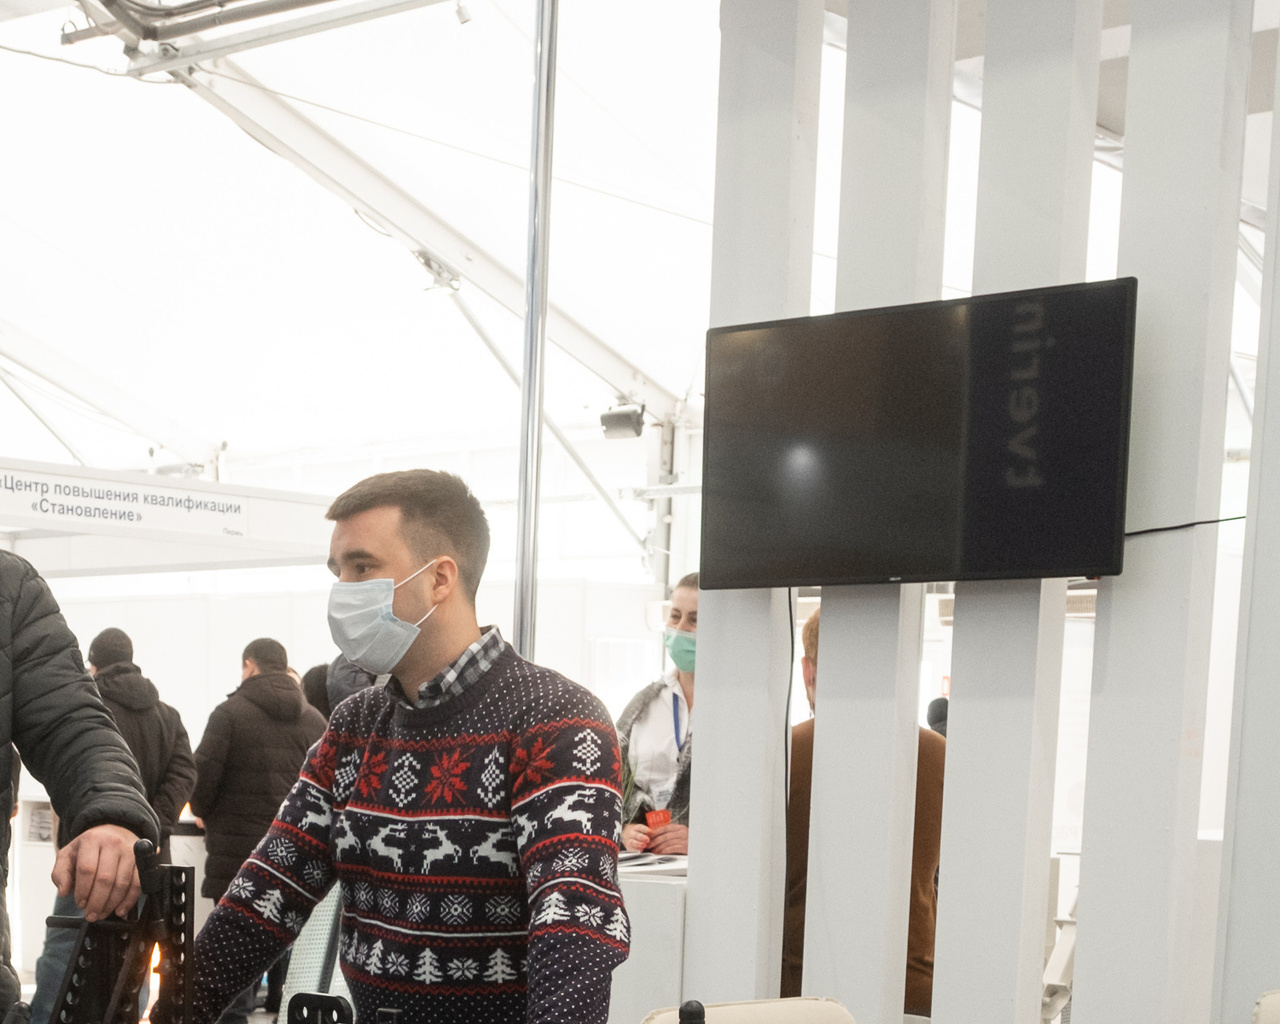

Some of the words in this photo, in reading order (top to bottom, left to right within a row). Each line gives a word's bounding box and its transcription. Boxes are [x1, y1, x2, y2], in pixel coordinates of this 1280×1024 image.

[31, 498, 142, 523] «Становление»
[53, 483, 139, 504] повышения
[143, 494, 241, 515] квалификации
